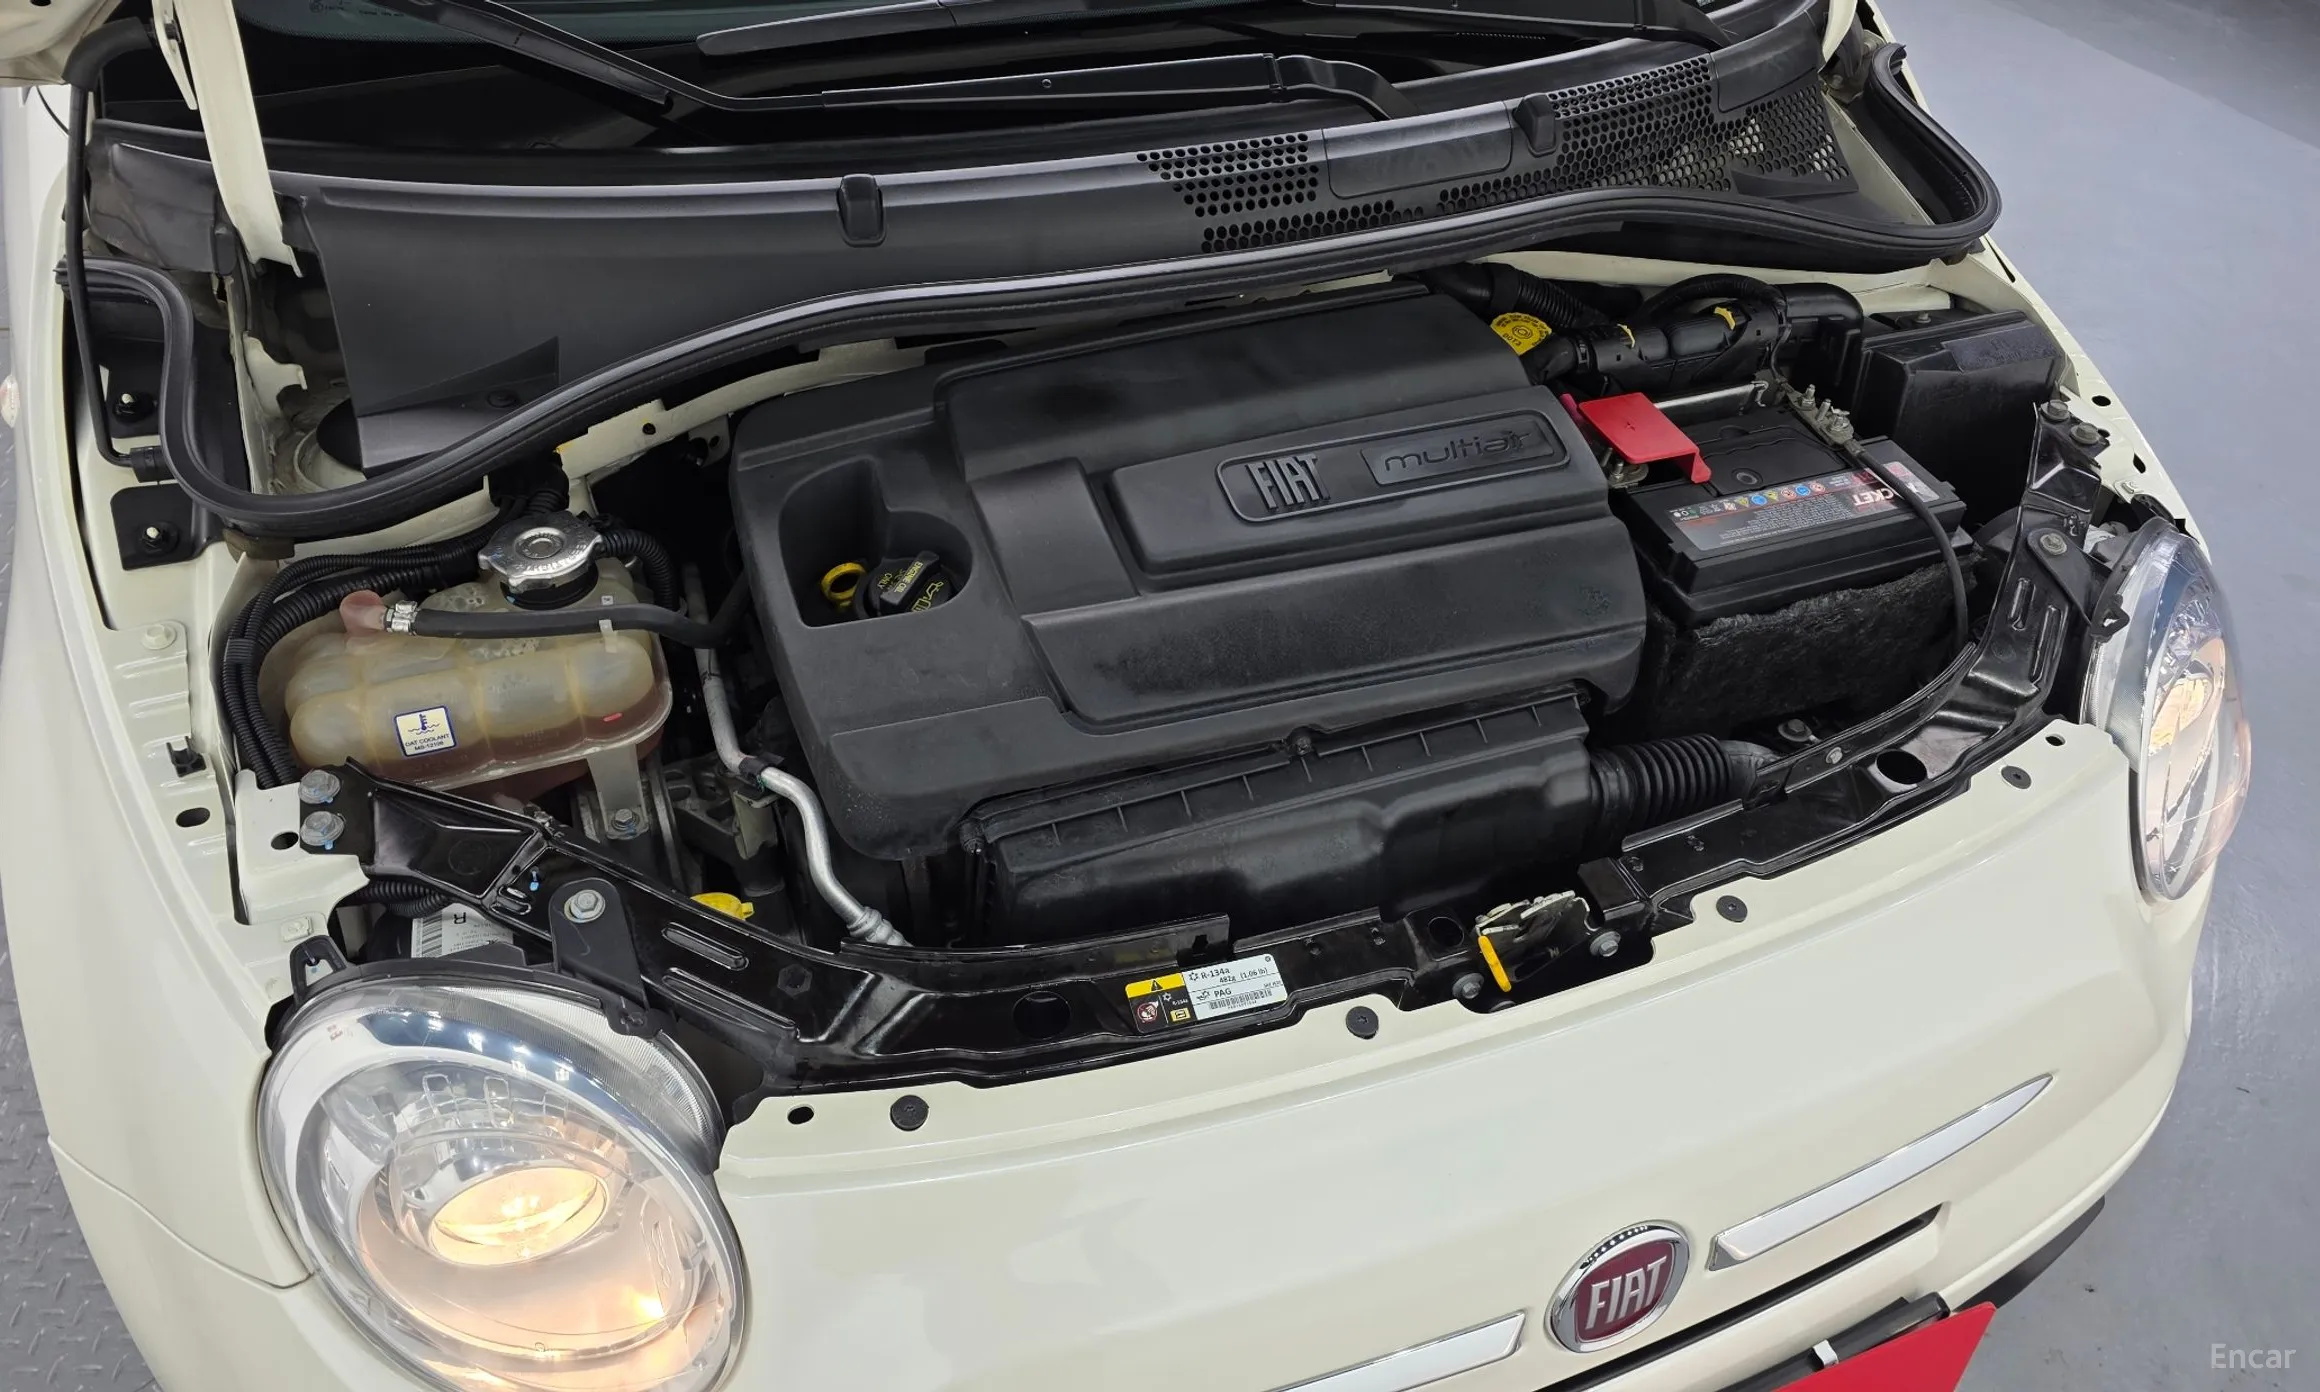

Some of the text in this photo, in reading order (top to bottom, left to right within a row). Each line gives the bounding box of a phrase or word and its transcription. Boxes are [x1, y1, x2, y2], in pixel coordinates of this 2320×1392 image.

[1384, 429, 1531, 473] multiair
[1246, 453, 1328, 510] FIAT
[420, 733, 450, 745] COOLANT
[454, 912, 467, 925] R
[1201, 968, 1231, 980] R-134a
[1213, 987, 1232, 998] PAG
[1585, 1255, 1668, 1331] FIAT
